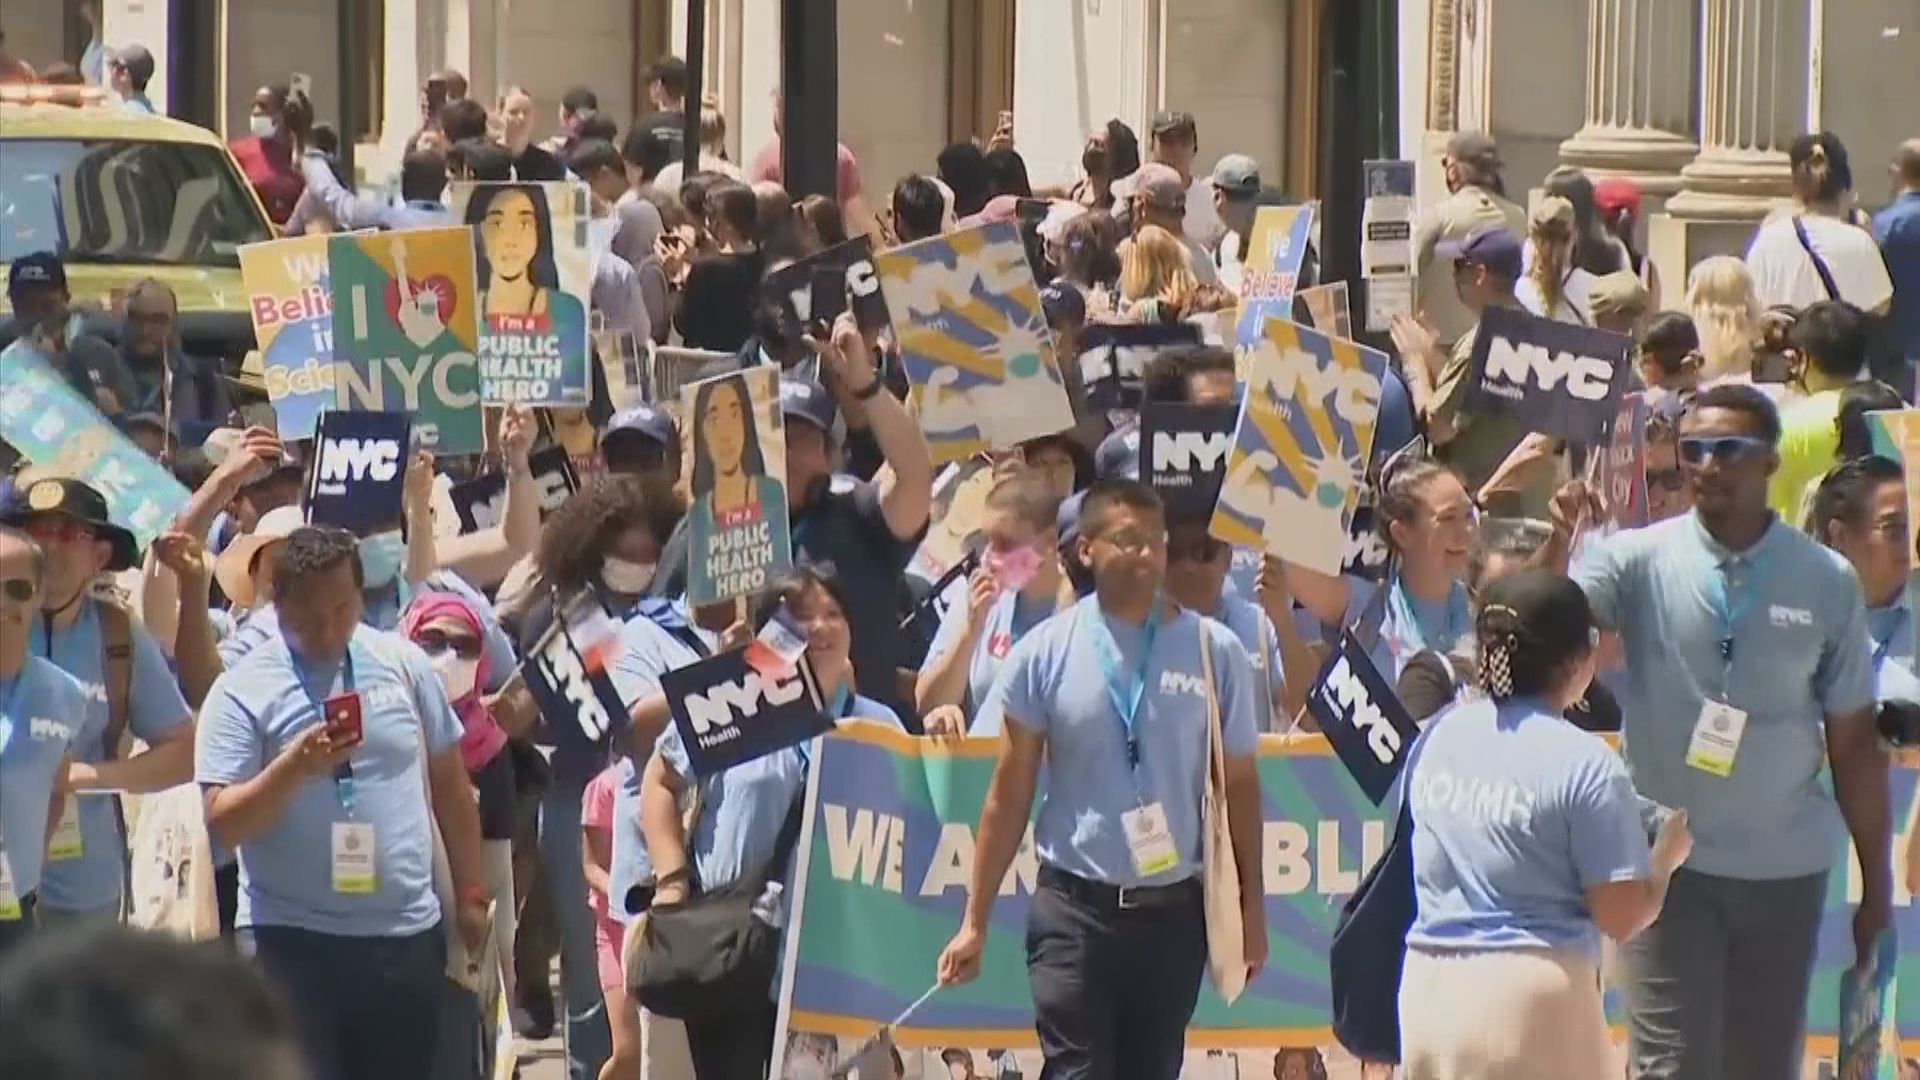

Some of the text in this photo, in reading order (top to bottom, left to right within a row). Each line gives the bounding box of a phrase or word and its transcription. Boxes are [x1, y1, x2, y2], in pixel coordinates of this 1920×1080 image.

[881, 240, 1036, 326] NYC
[351, 285, 369, 341] I
[334, 351, 479, 413] NYC
[1249, 339, 1382, 426] NYC
[1485, 336, 1614, 400] NYC
[320, 437, 399, 481] NYC
[706, 542, 773, 579] HEALTH
[709, 521, 769, 556] PUBLIC
[715, 567, 766, 598] HERO
[684, 669, 804, 735] NYC
[1326, 655, 1401, 764] NYC
[699, 725, 742, 750] Health
